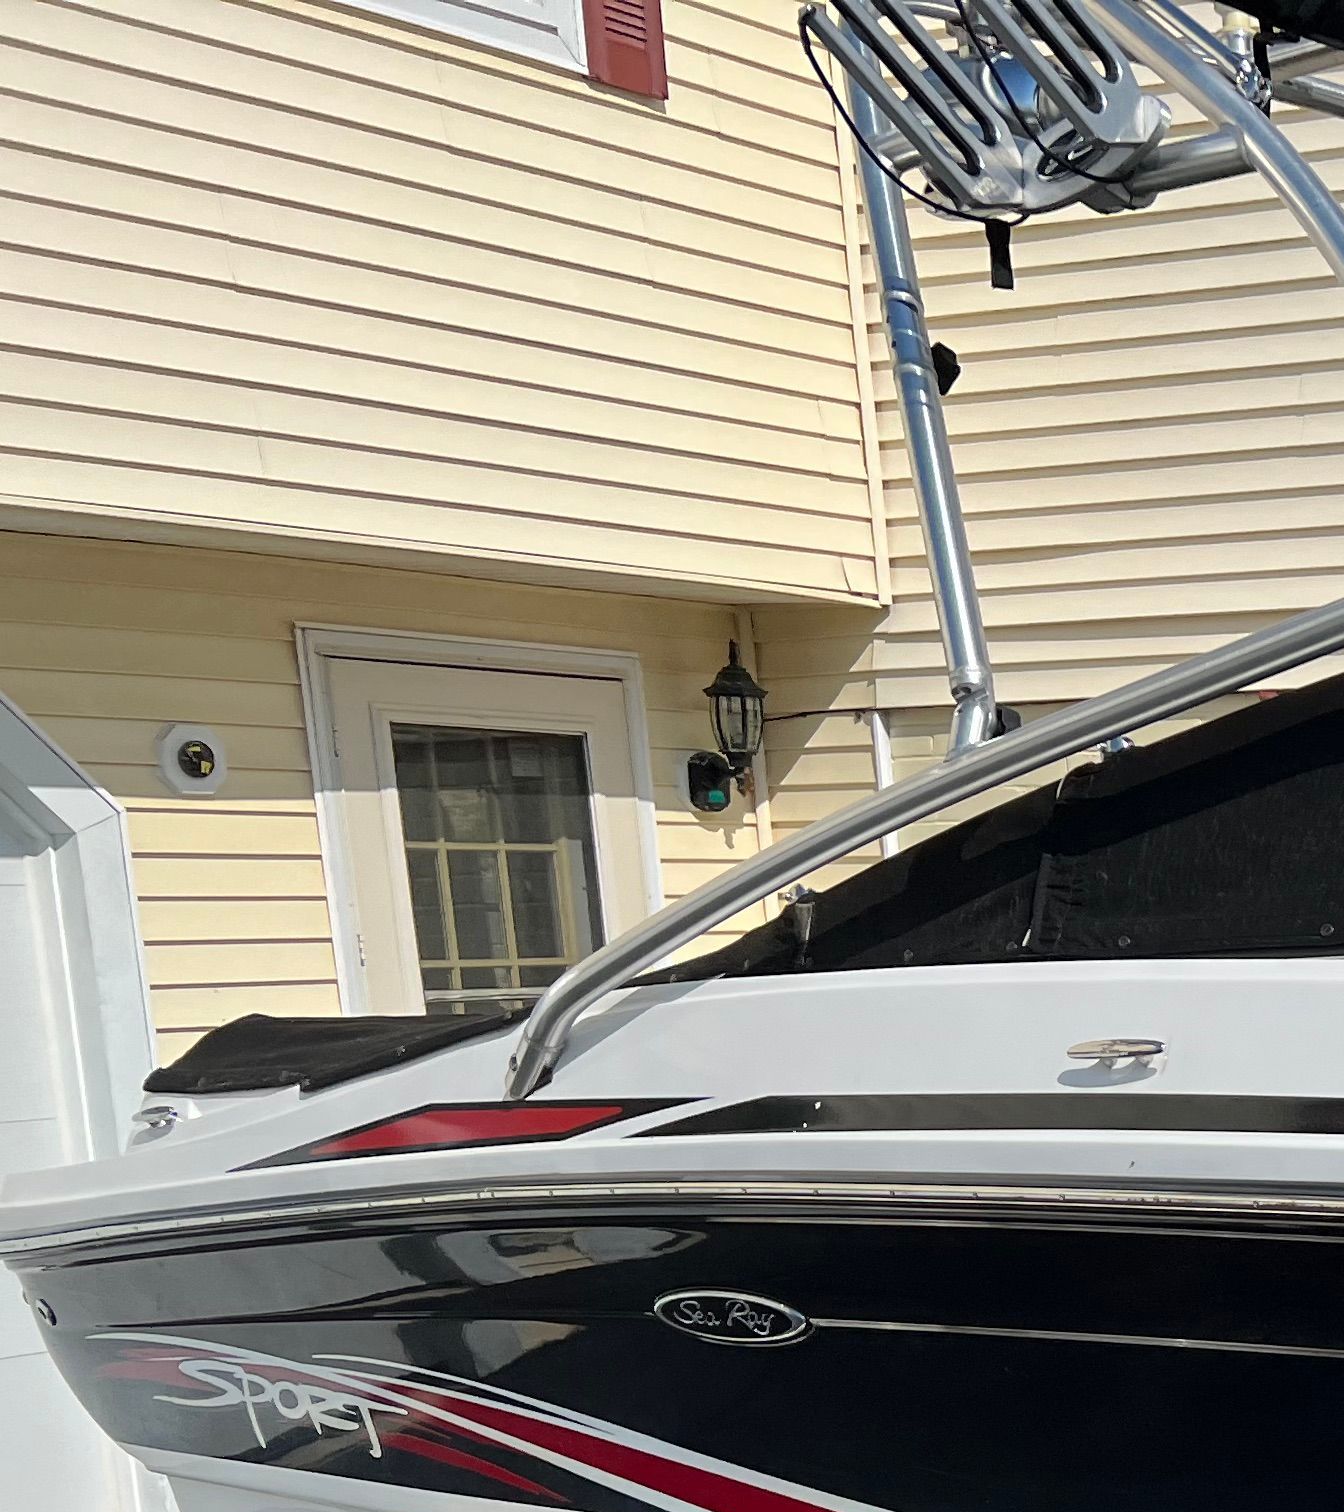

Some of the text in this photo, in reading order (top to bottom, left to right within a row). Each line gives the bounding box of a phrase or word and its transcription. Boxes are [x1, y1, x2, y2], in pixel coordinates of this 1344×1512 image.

[673, 1299, 775, 1336] Sea Ray
[152, 1359, 409, 1459] SPORT
